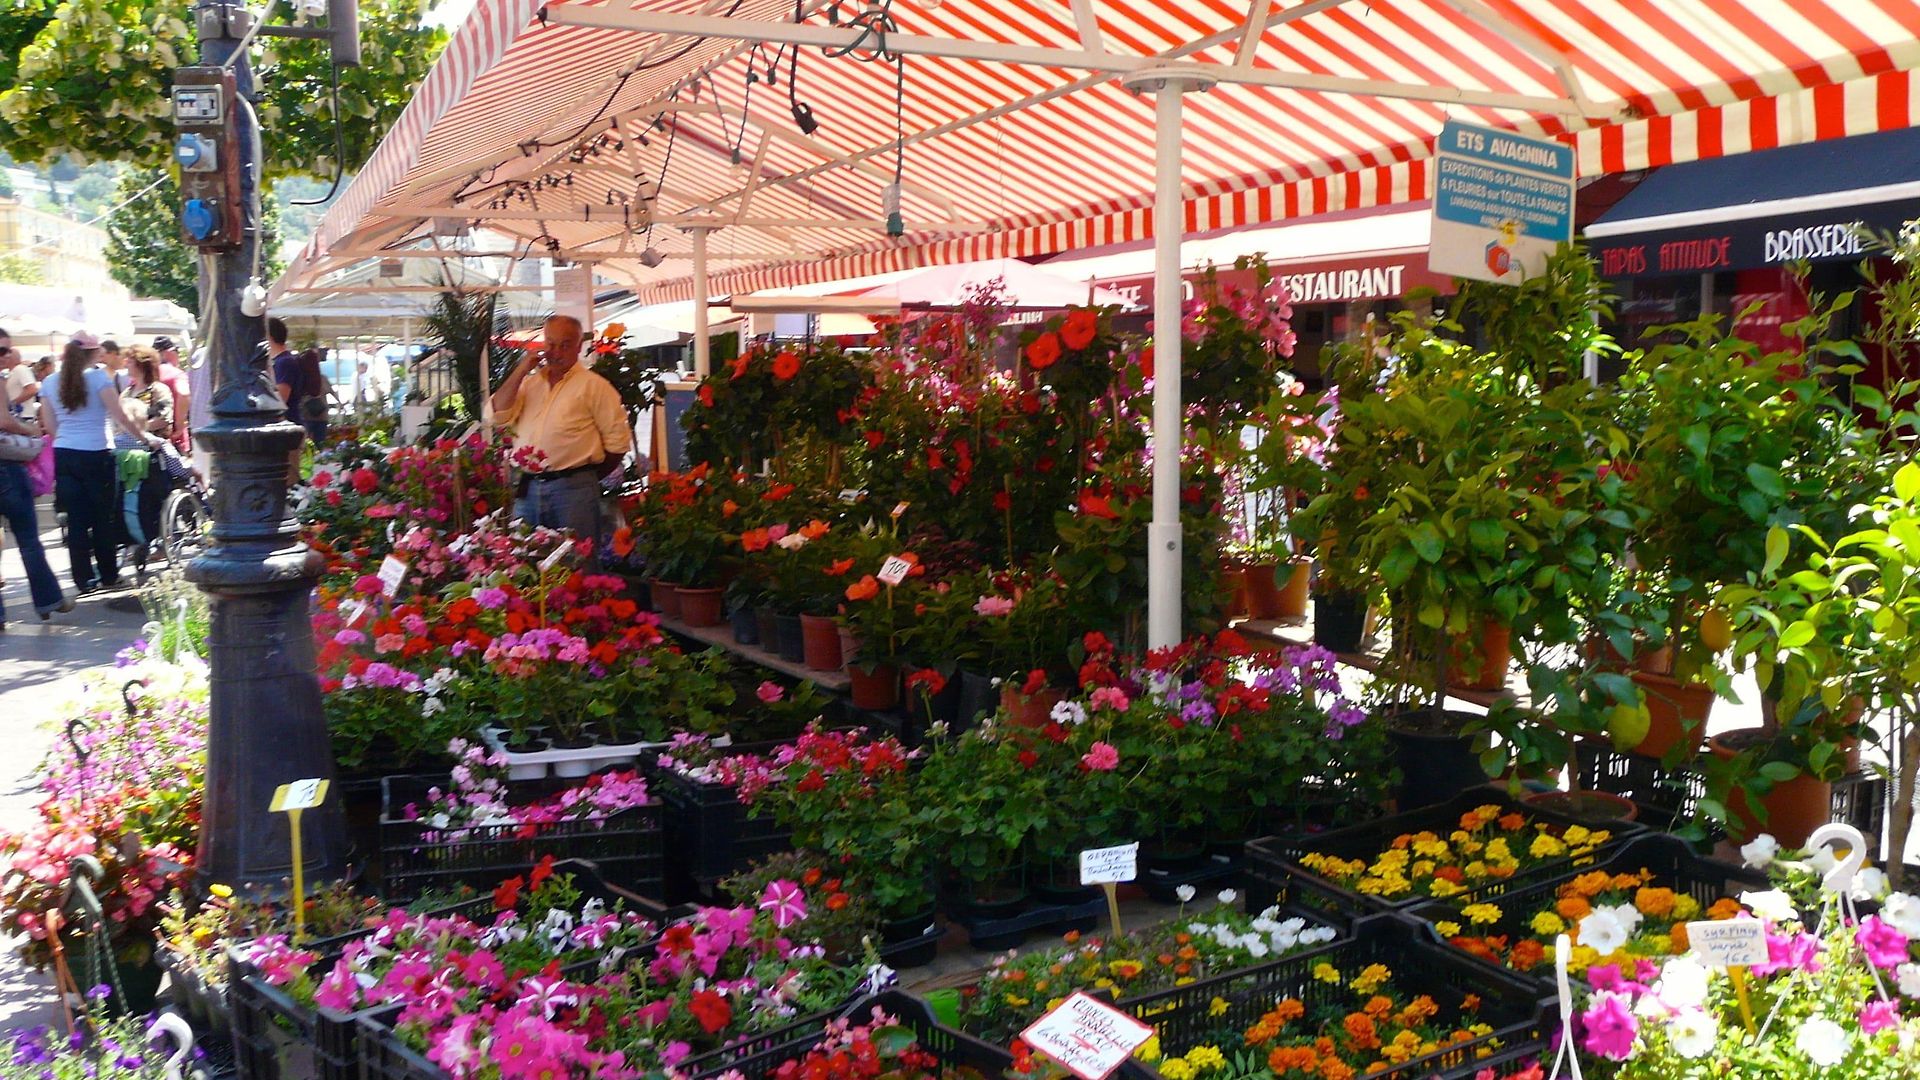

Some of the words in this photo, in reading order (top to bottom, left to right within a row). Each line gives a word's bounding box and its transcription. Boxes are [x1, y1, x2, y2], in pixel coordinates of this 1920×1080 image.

[1456, 129, 1484, 153] ETS
[1489, 137, 1558, 169] AVAGNINA
[1500, 189, 1527, 207] TOUTE
[1505, 173, 1539, 192] PLANTES
[1602, 244, 1646, 276] TAPAS
[1658, 236, 1732, 271] ATTITUDE
[1764, 220, 1864, 263] BRASSERIE
[1278, 264, 1405, 303] ESTAURANT
